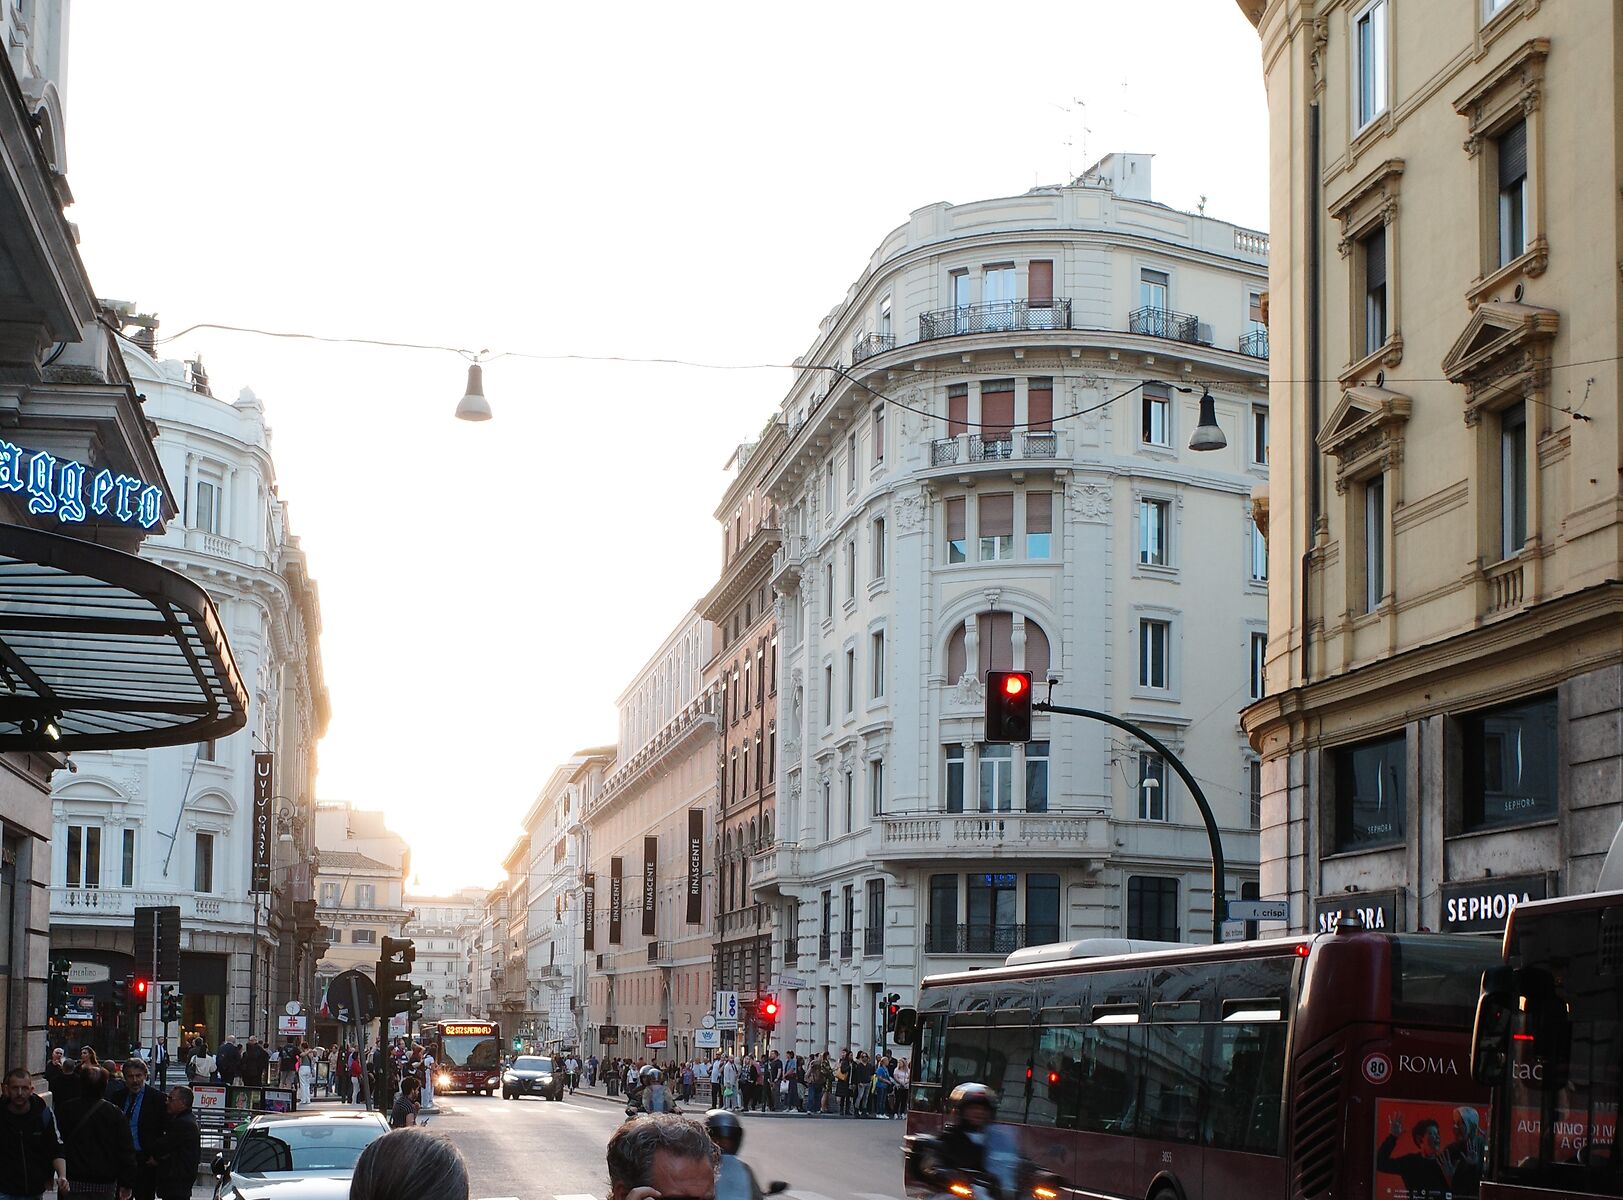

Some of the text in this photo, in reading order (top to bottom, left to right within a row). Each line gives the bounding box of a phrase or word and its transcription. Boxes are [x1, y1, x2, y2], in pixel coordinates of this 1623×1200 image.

[1504, 797, 1536, 811] SEPHORA
[1367, 823, 1393, 835] SEPHORA
[692, 838, 700, 895] RINASCENTE
[646, 862, 654, 911] RINASCENTE
[1262, 909, 1285, 918] crispi
[445, 1026, 455, 1035] 62
[1370, 1061, 1385, 1074] 80
[1399, 1054, 1543, 1080] ROMA tac
